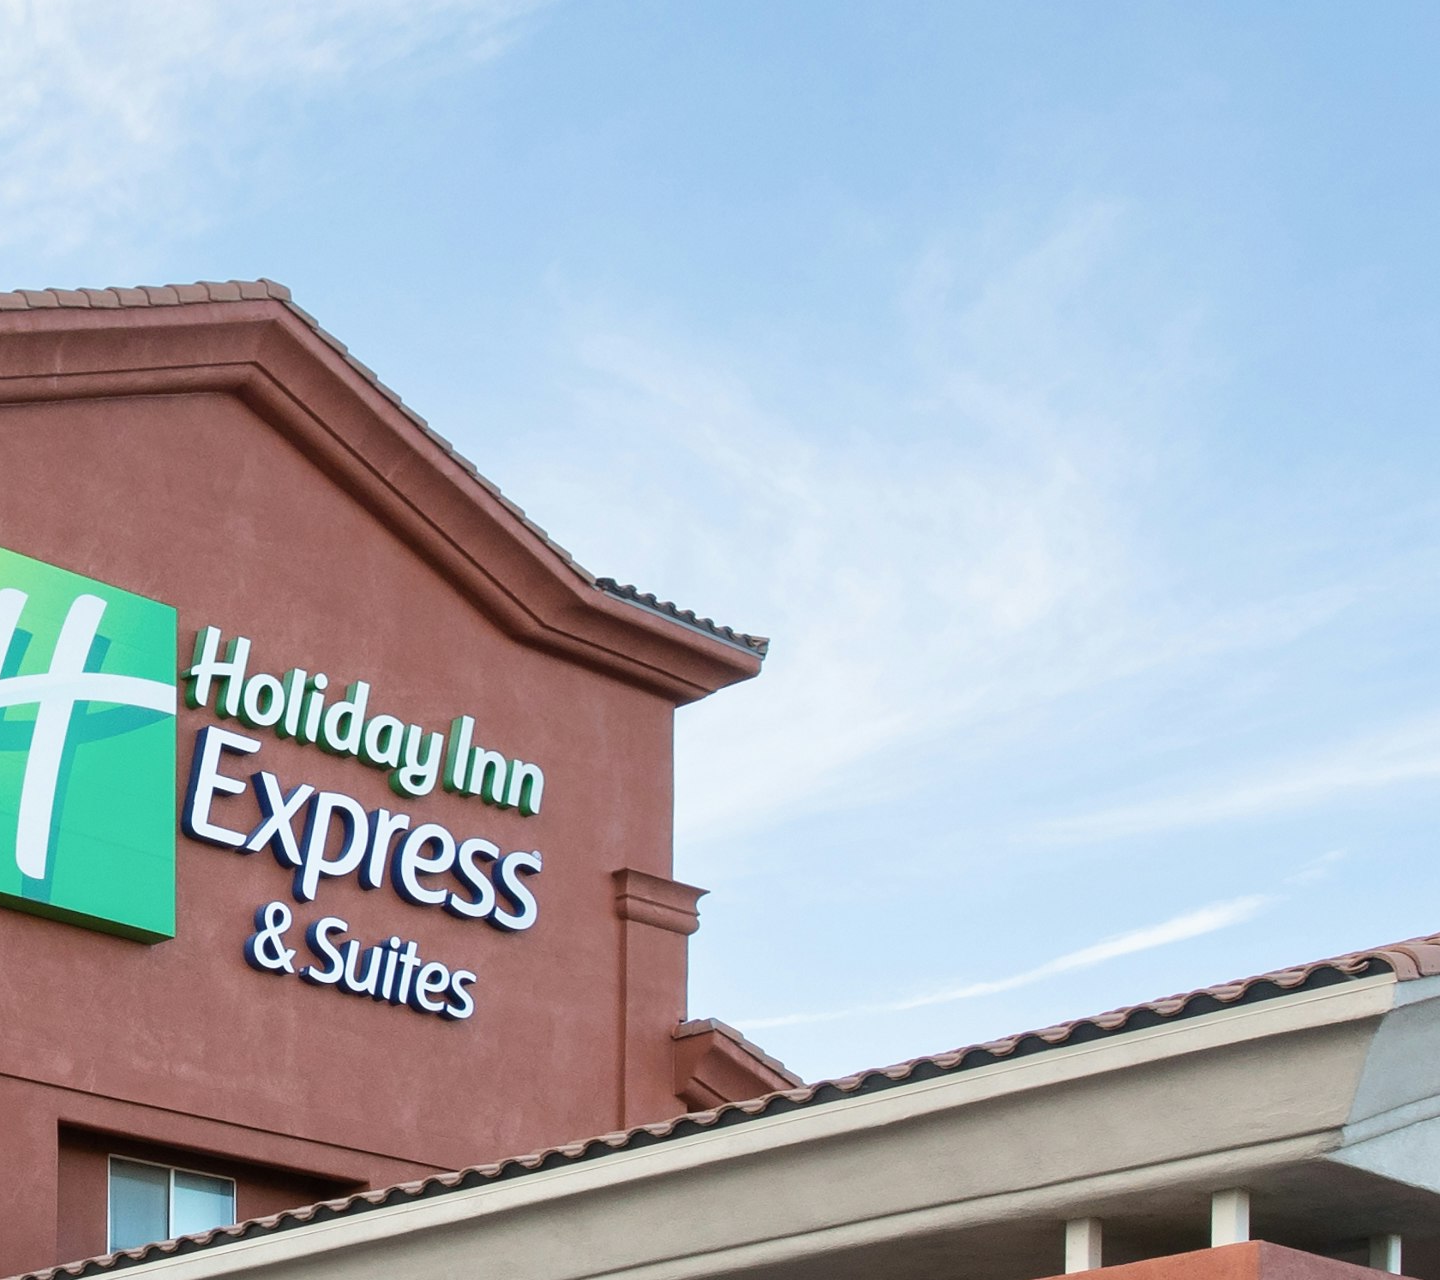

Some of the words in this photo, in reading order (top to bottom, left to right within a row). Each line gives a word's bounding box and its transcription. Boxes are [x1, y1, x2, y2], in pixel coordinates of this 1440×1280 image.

[189, 624, 445, 797] Holiday
[451, 714, 546, 816] Inn
[190, 725, 544, 932] Express
[252, 901, 298, 974] &
[307, 916, 478, 1020] Suites
